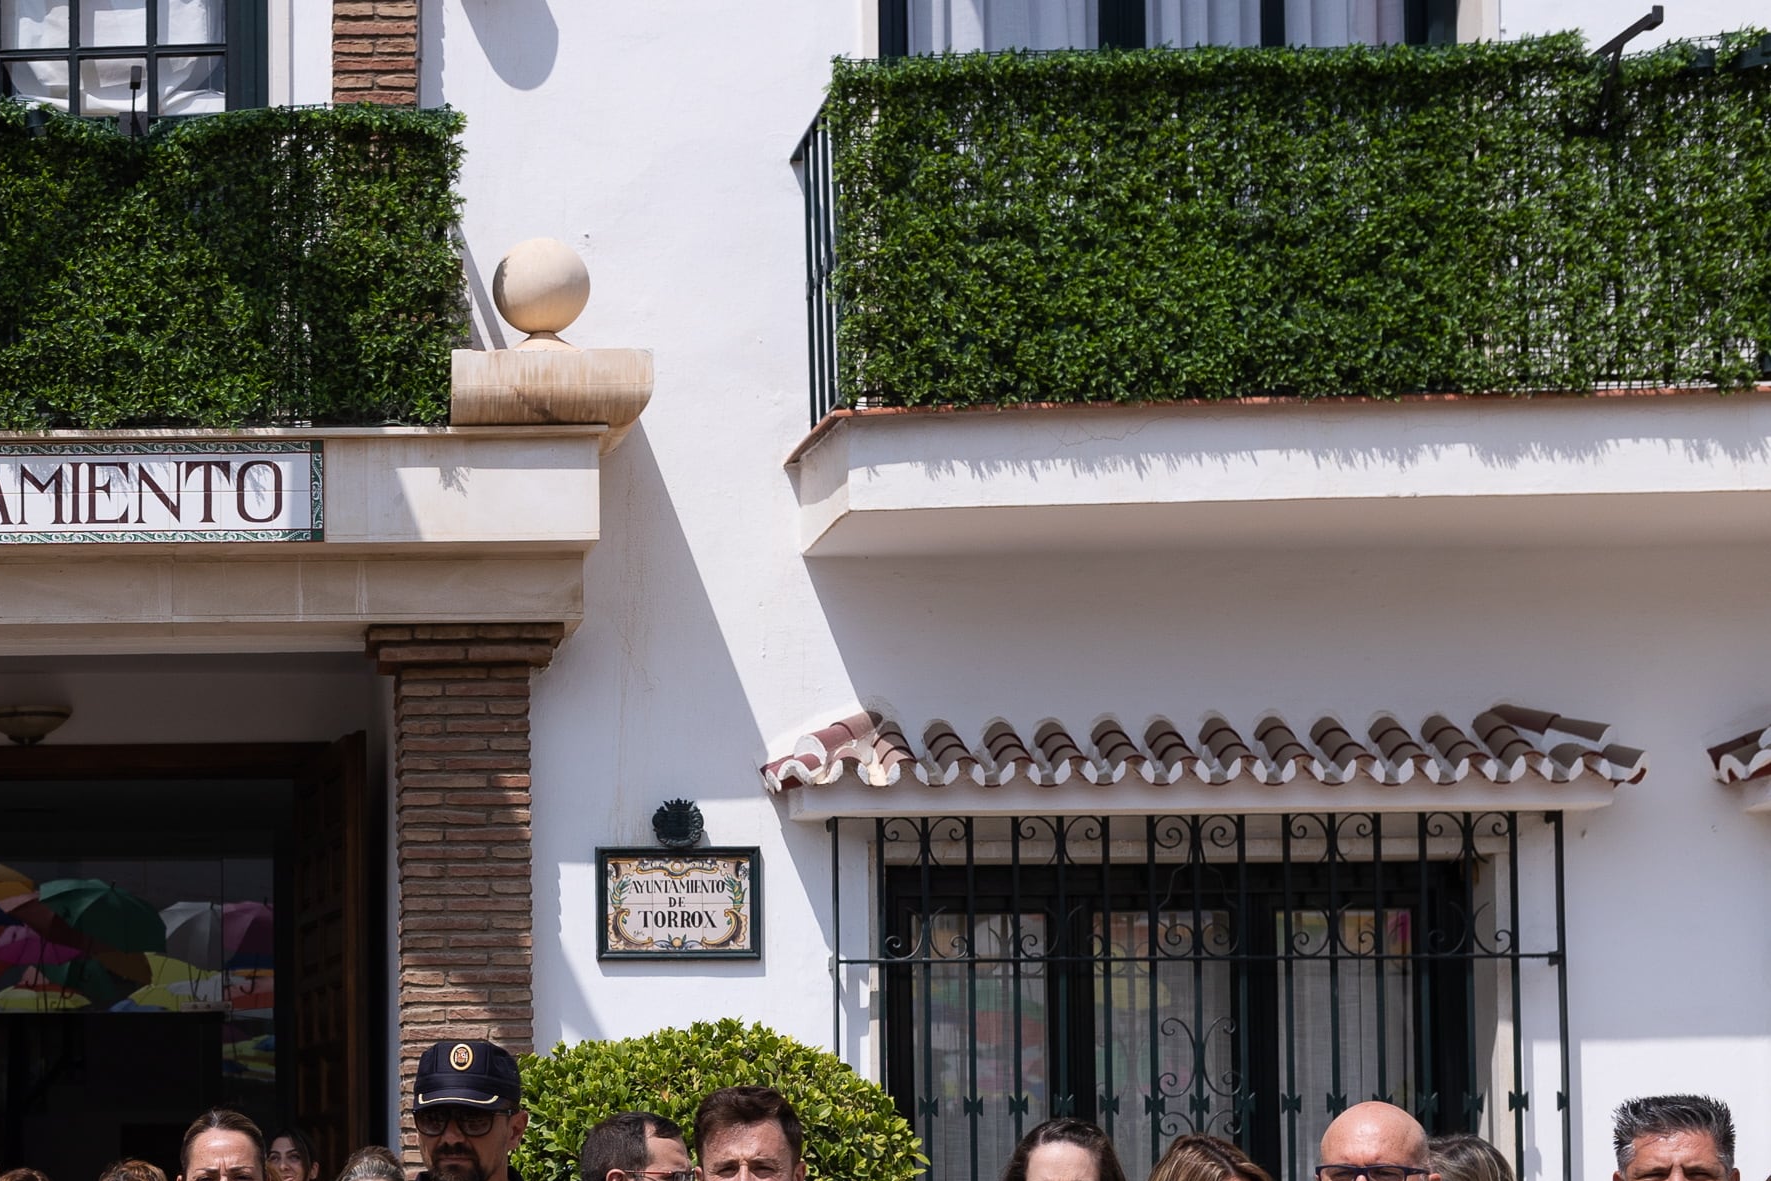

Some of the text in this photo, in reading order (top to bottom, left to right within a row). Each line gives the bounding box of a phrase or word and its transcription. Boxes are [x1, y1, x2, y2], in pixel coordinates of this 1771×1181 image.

[628, 879, 725, 894] AYUNTAMIENTO
[668, 896, 686, 908] DE
[637, 910, 717, 928] TORROX
